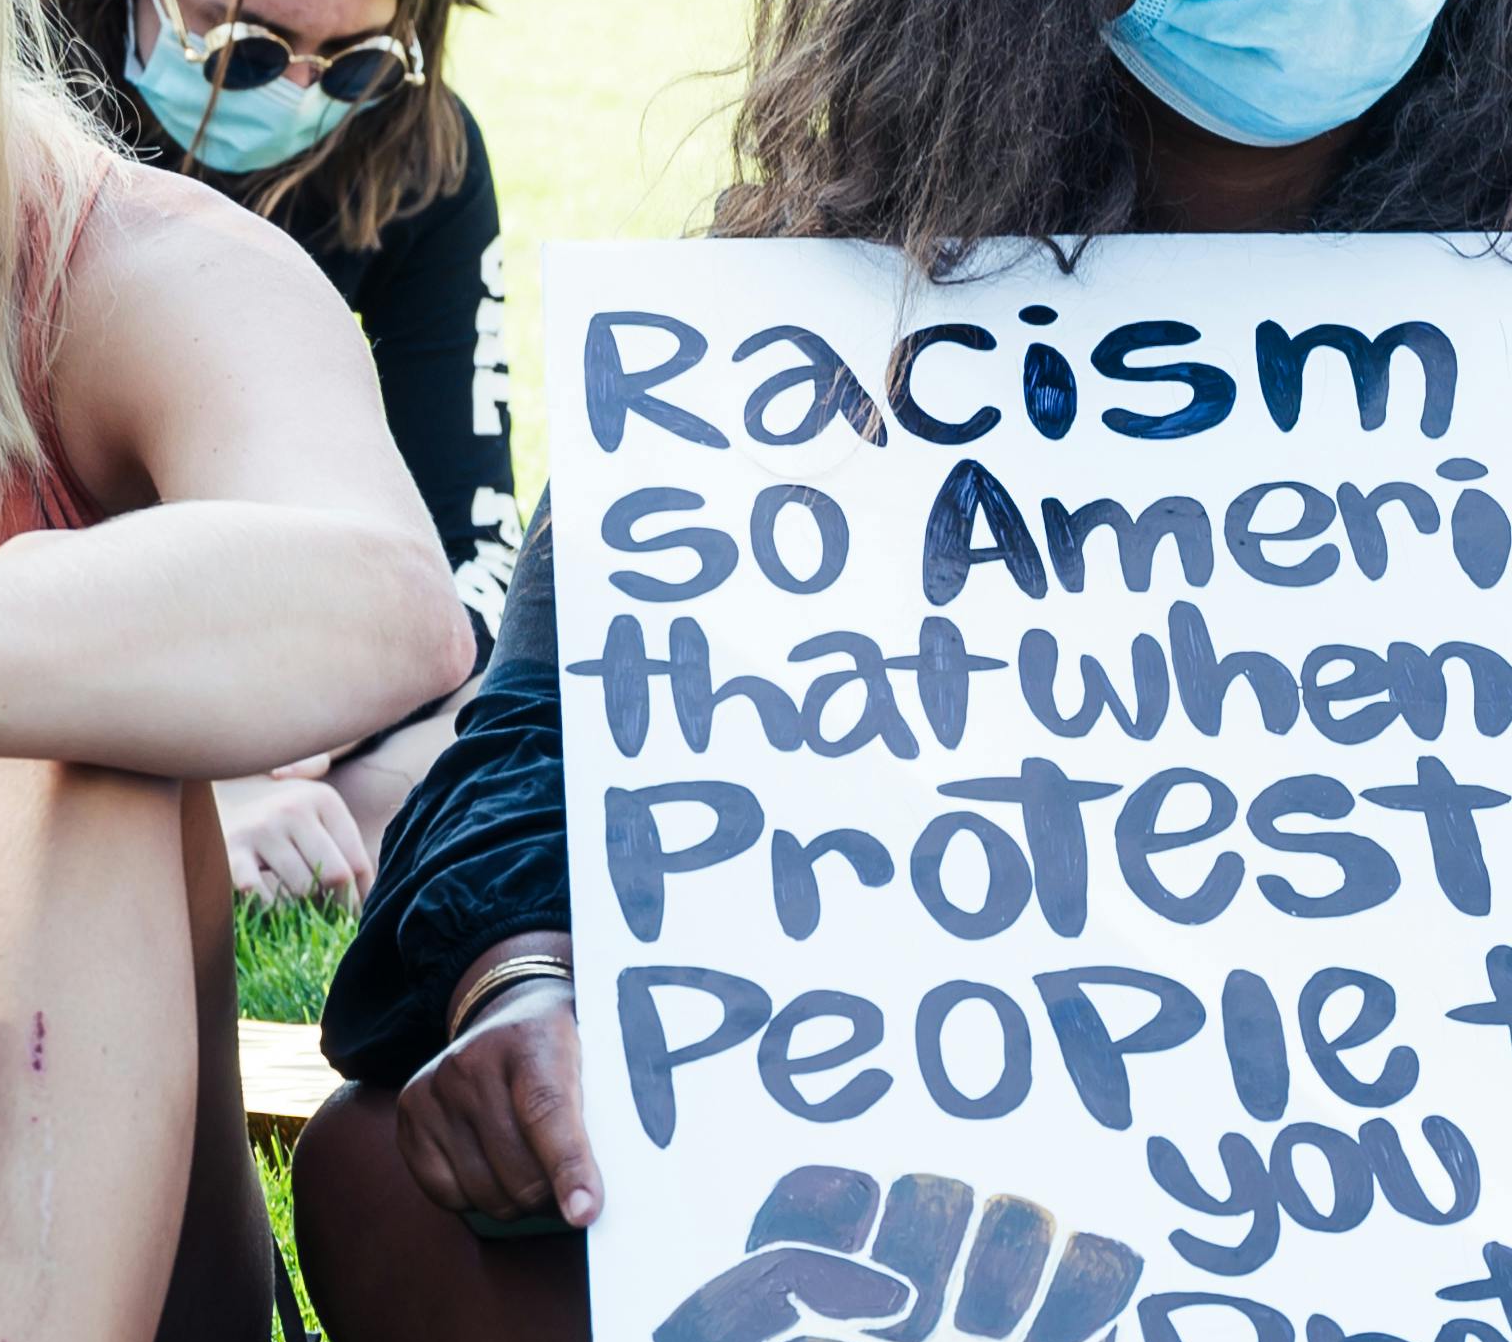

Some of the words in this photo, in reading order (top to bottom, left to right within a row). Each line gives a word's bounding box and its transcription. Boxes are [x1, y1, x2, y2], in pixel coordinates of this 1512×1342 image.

[584, 305, 1458, 453] Racism
[566, 615, 1008, 759] that
[604, 756, 1512, 943] Protest
[1147, 1115, 1480, 1276] you
